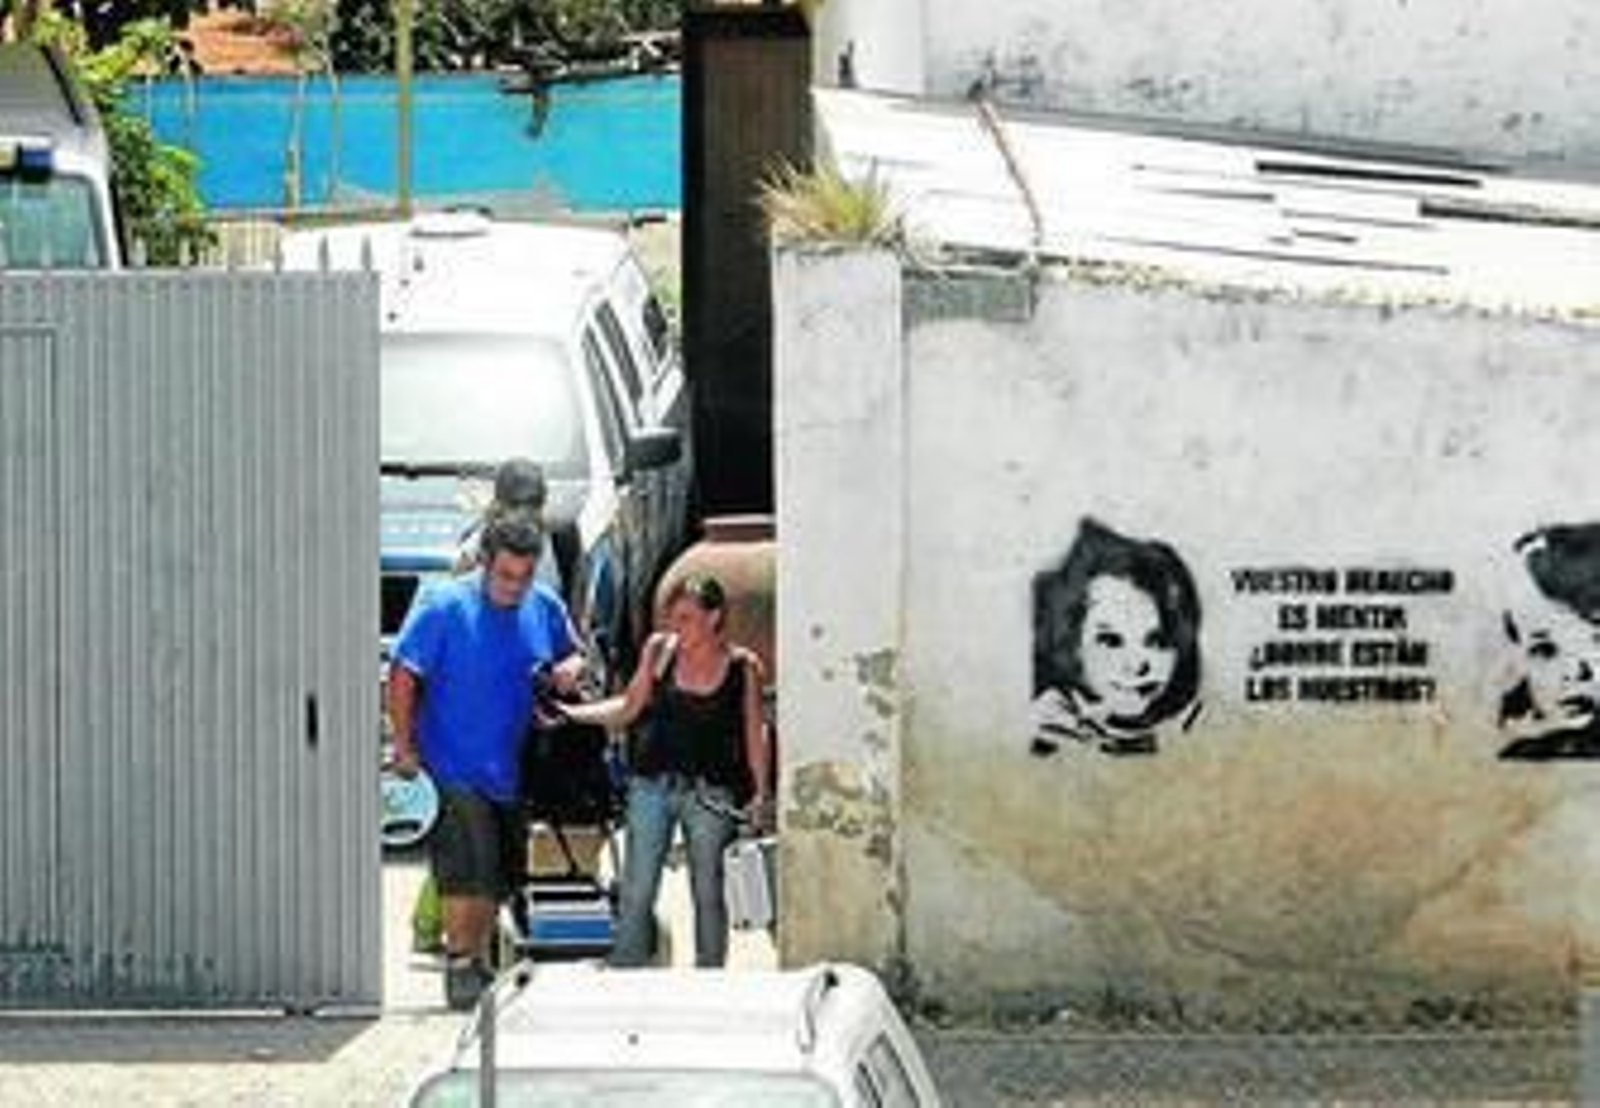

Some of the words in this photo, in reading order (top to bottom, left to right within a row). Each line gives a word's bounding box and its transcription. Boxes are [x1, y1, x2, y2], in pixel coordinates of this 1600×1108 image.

[1230, 569, 1336, 594] VUESTRO
[1344, 569, 1454, 594] DERECHO
[1278, 604, 1308, 630] ES
[1245, 676, 1292, 702] LOS
[1298, 676, 1437, 702] NUESTROS?
